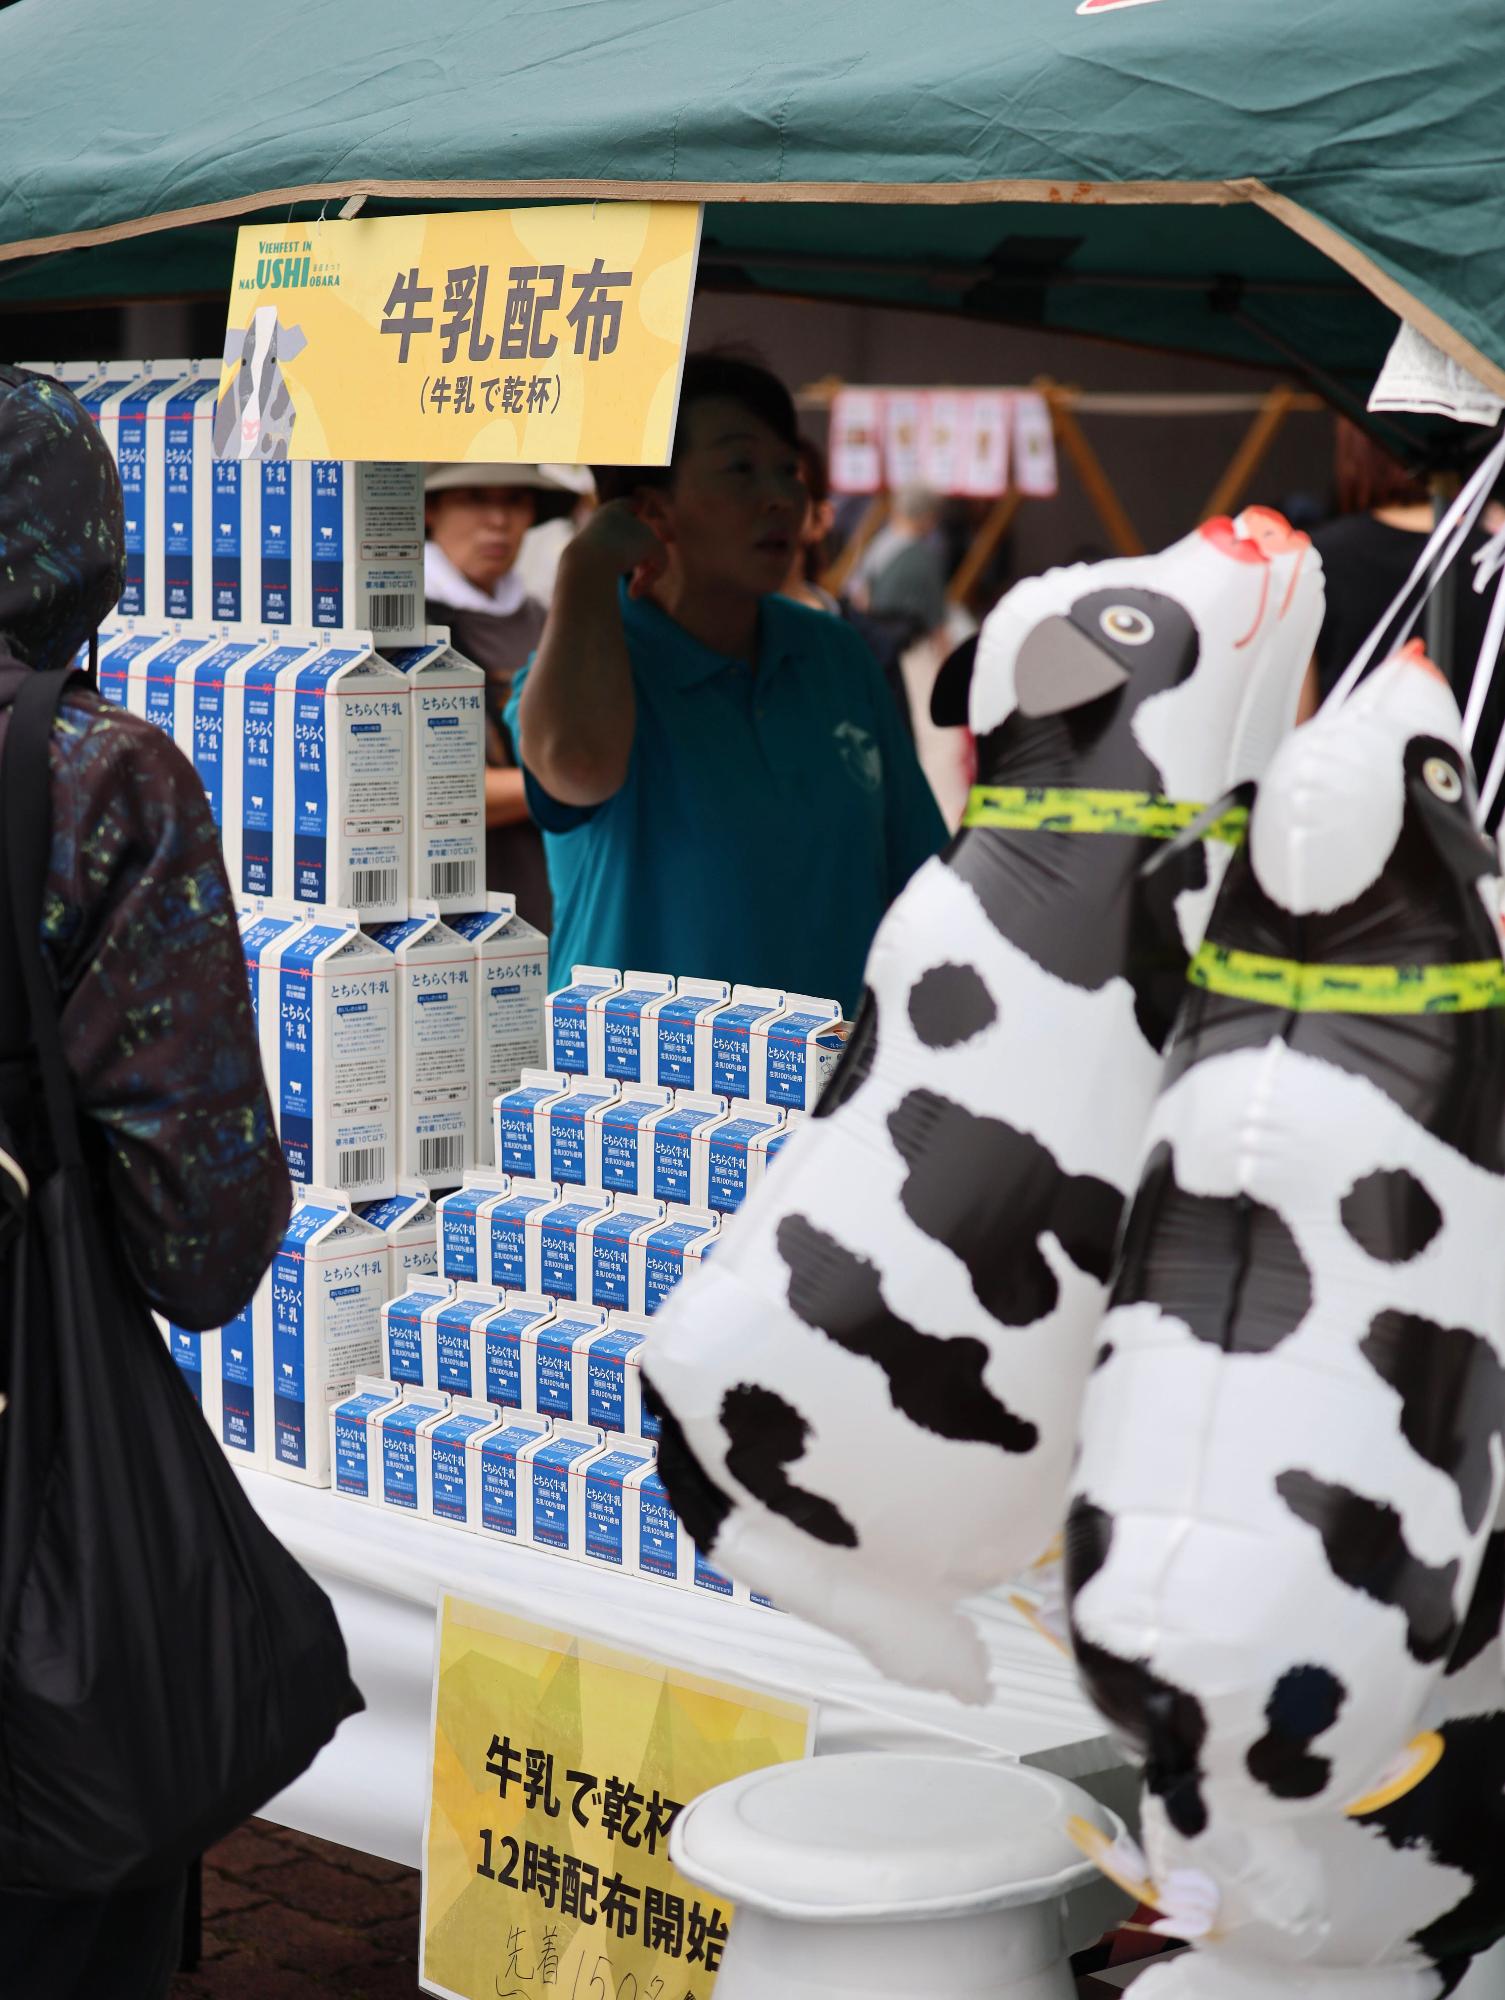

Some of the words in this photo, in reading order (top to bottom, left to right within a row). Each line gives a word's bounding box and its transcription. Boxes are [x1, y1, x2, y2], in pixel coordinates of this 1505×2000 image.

[380, 257, 632, 364] 牛乳配布
[420, 374, 562, 415] (牛乳で乾杯)
[345, 702, 402, 716] とちらく牛乳
[422, 696, 480, 710] とちらく牛乳
[195, 715, 222, 733] とちらく
[245, 719, 272, 738] とちらく
[295, 724, 324, 742] とちらく
[198, 733, 218, 750] 牛乳
[248, 738, 268, 754] 牛乳
[299, 742, 320, 759] 牛乳
[411, 971, 469, 987] とちらく牛乳
[487, 963, 542, 980] とちらく牛乳
[331, 980, 389, 998] とちらく牛乳
[282, 1002, 311, 1023] とちらく
[286, 1021, 306, 1040] 牛乳
[324, 1260, 381, 1283] とちらく牛乳
[274, 1284, 302, 1306] とちらく
[278, 1304, 298, 1323] 牛乳
[230, 1434, 246, 1446] 1000ml
[336, 1427, 366, 1443] とちらく牛乳
[384, 1438, 415, 1454] とちらく牛乳
[282, 1450, 298, 1462] 1000ml
[433, 1450, 464, 1467] とちらく牛乳
[483, 1462, 515, 1480] とちらく牛乳
[533, 1475, 567, 1493] とちらく牛乳
[586, 1487, 621, 1507] とちらく牛乳
[641, 1501, 676, 1521] とちらく牛乳
[476, 1828, 730, 1973] 12時配布開始
